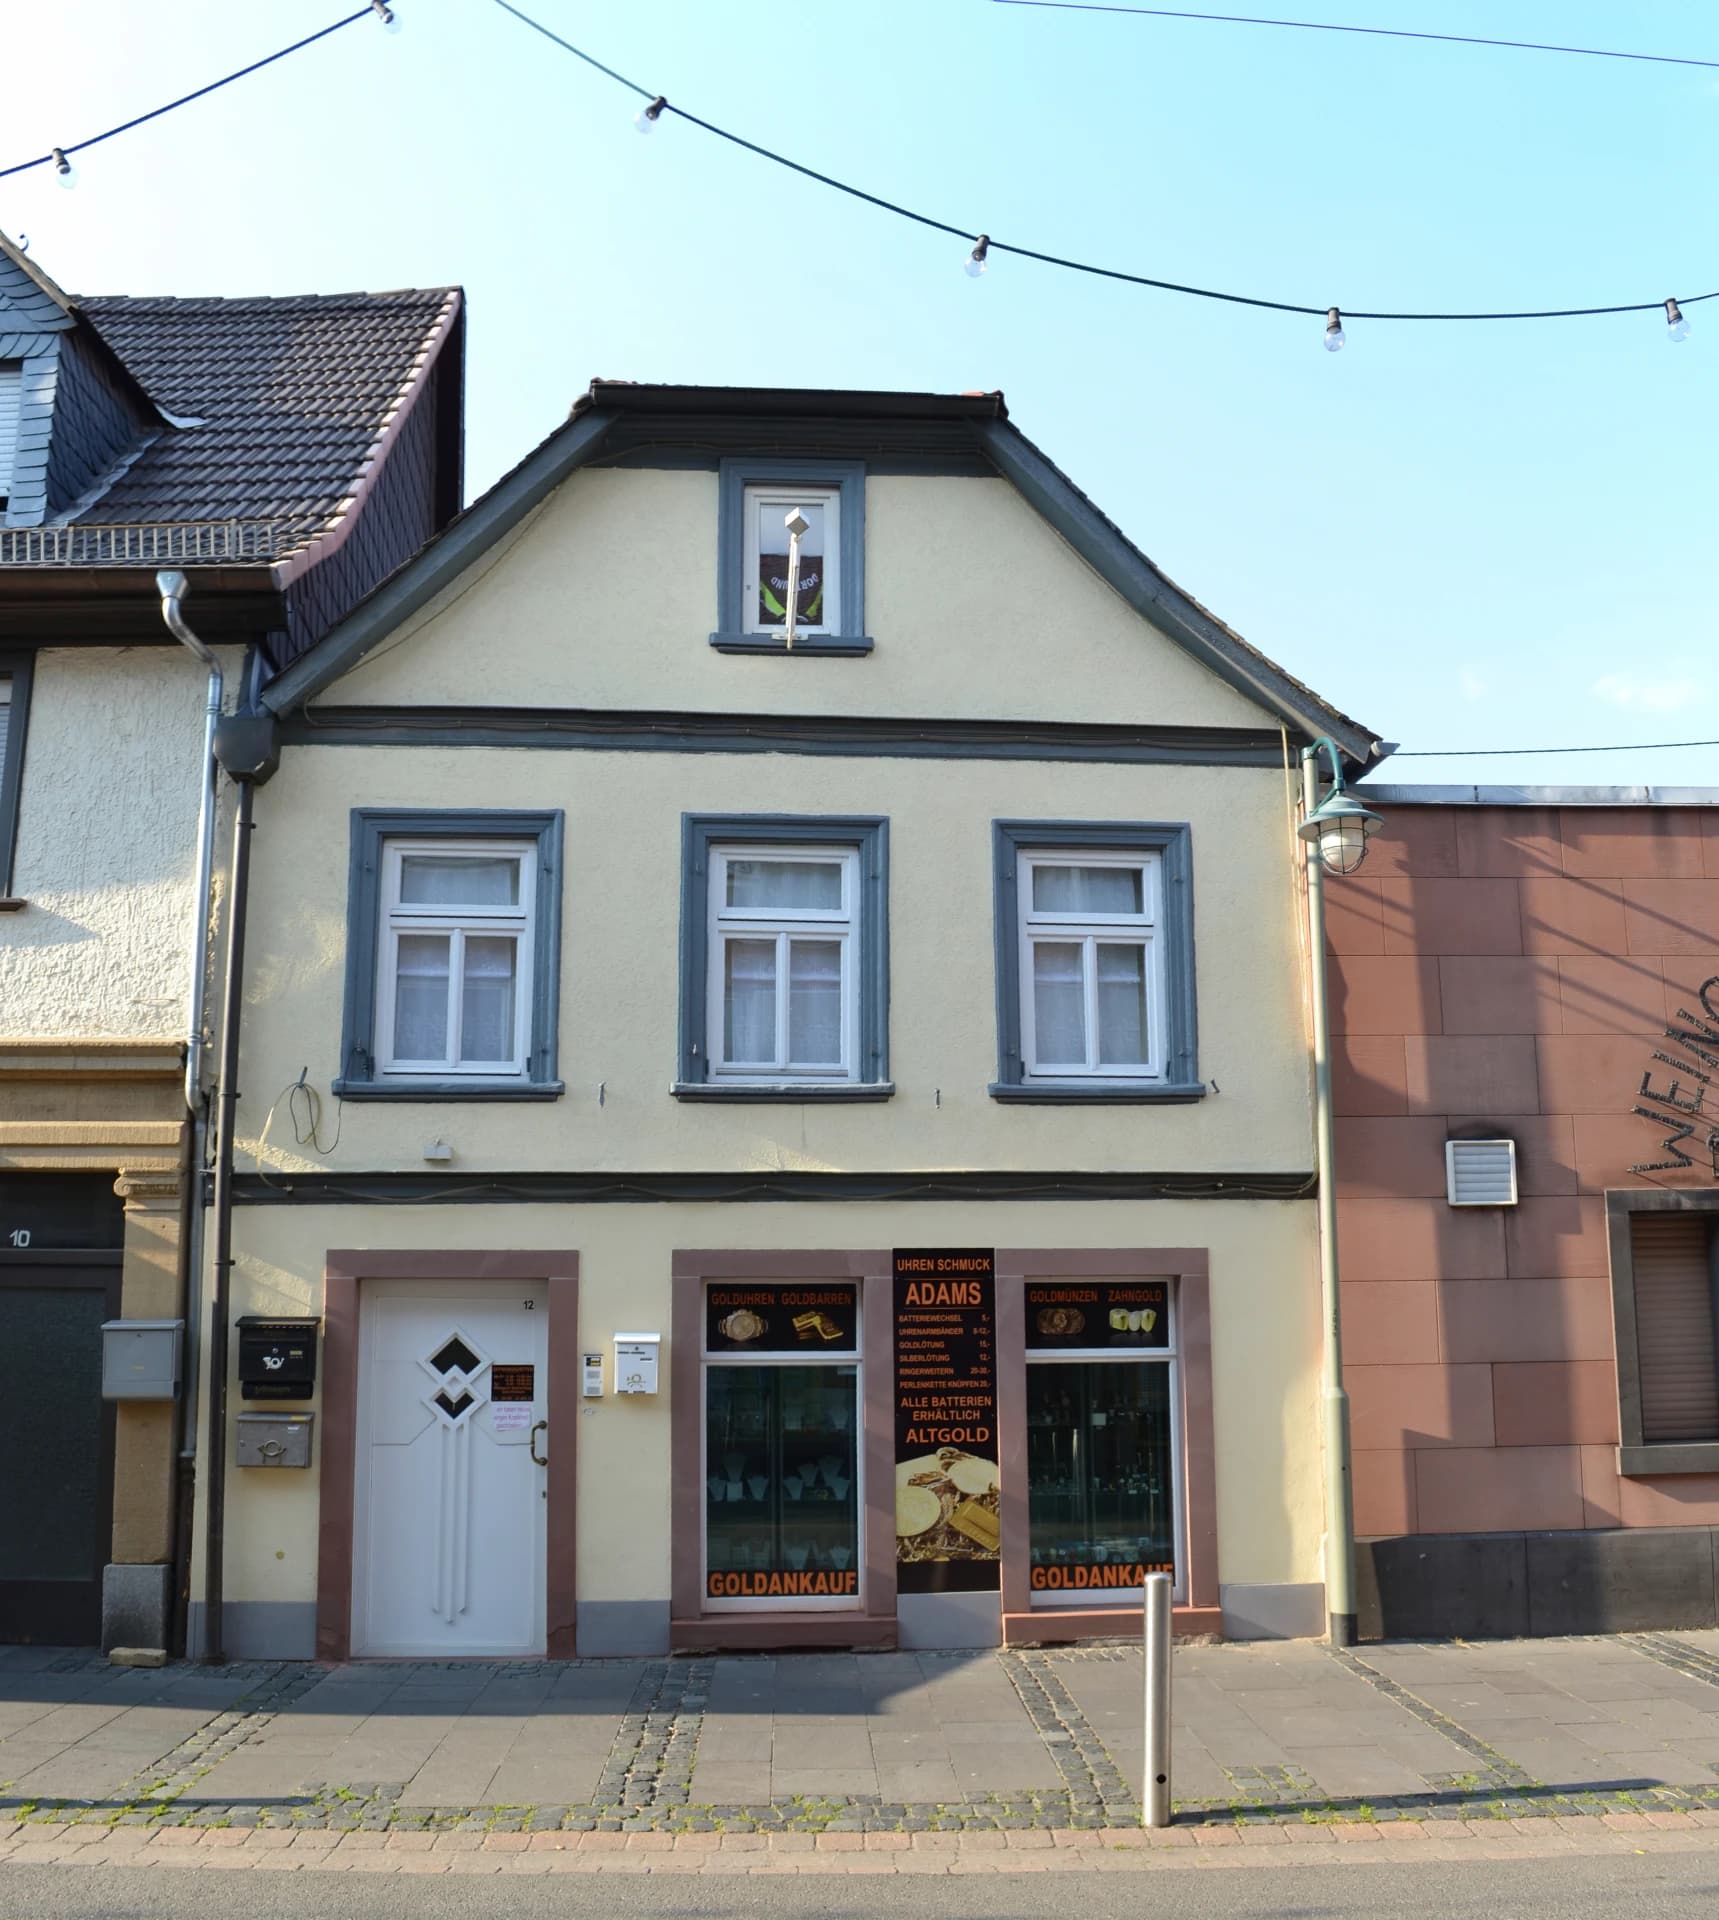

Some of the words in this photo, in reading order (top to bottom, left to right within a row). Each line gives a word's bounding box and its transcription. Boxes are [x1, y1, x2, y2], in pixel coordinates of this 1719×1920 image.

[9, 1229, 31, 1247] 10
[897, 1258, 935, 1271] UHREN
[937, 1258, 991, 1271] SCHMUCK
[711, 1292, 776, 1305] GOLDUHREN
[781, 1292, 852, 1305] GOLDBARREN
[905, 1281, 982, 1305] ADAMS
[1030, 1289, 1098, 1303] GOLDMÜNZEN
[1107, 1289, 1162, 1303] ZAHNGOLD
[523, 1300, 535, 1310] 12
[899, 1314, 963, 1322] BATTERIEWECHSEL
[899, 1339, 945, 1349] GOLDLÖTUNG
[899, 1353, 951, 1362] SILBERLÖTUNG
[899, 1367, 955, 1376] RINGERWEITERN
[900, 1380, 946, 1389] PERLENKETTE
[901, 1396, 929, 1408] ALLE
[931, 1395, 992, 1408] BATTERIEN
[912, 1408, 981, 1421] ERHÄLTLICH
[905, 1427, 990, 1443] ALTGOLD
[709, 1571, 856, 1596] GOLDANKAUF
